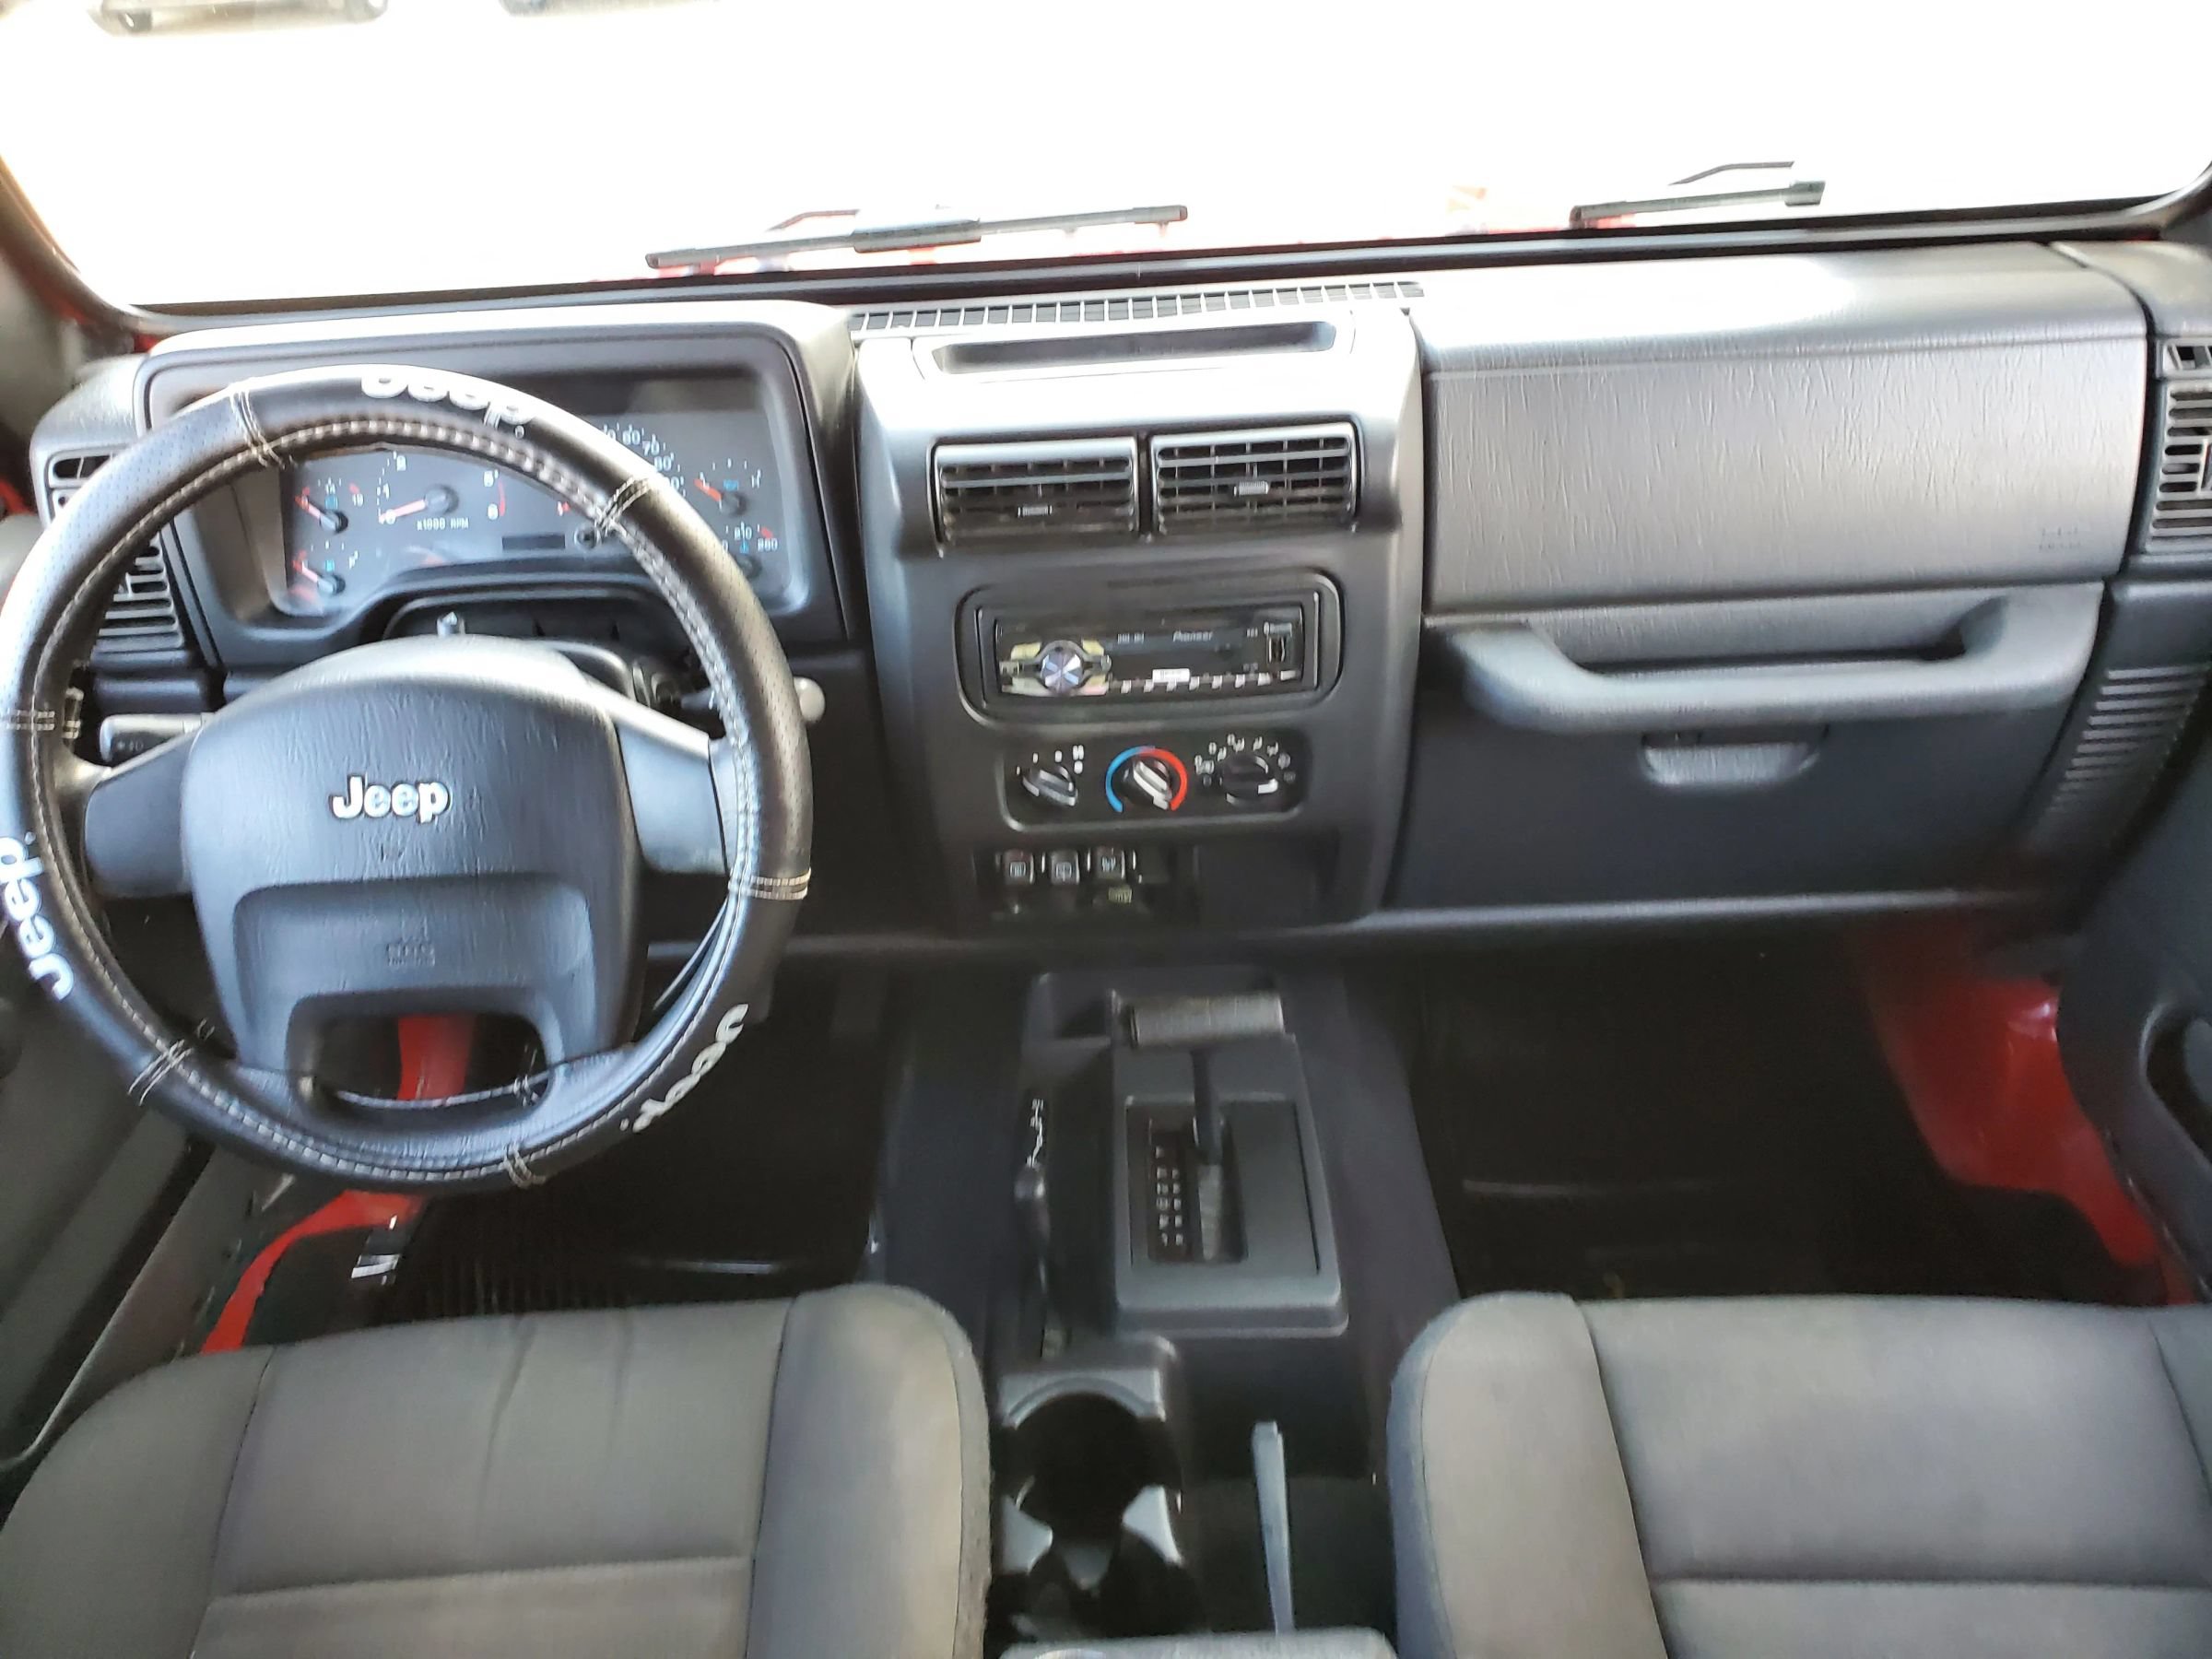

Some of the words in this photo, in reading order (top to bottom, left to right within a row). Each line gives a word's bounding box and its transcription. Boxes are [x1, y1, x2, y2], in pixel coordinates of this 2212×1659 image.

[642, 439, 660, 455] 70
[653, 456, 672, 471] 80
[450, 517, 469, 530] RPM
[331, 774, 450, 823] Jeep
[0, 837, 74, 1001] Jeep
[632, 1003, 749, 1133] Jeep
